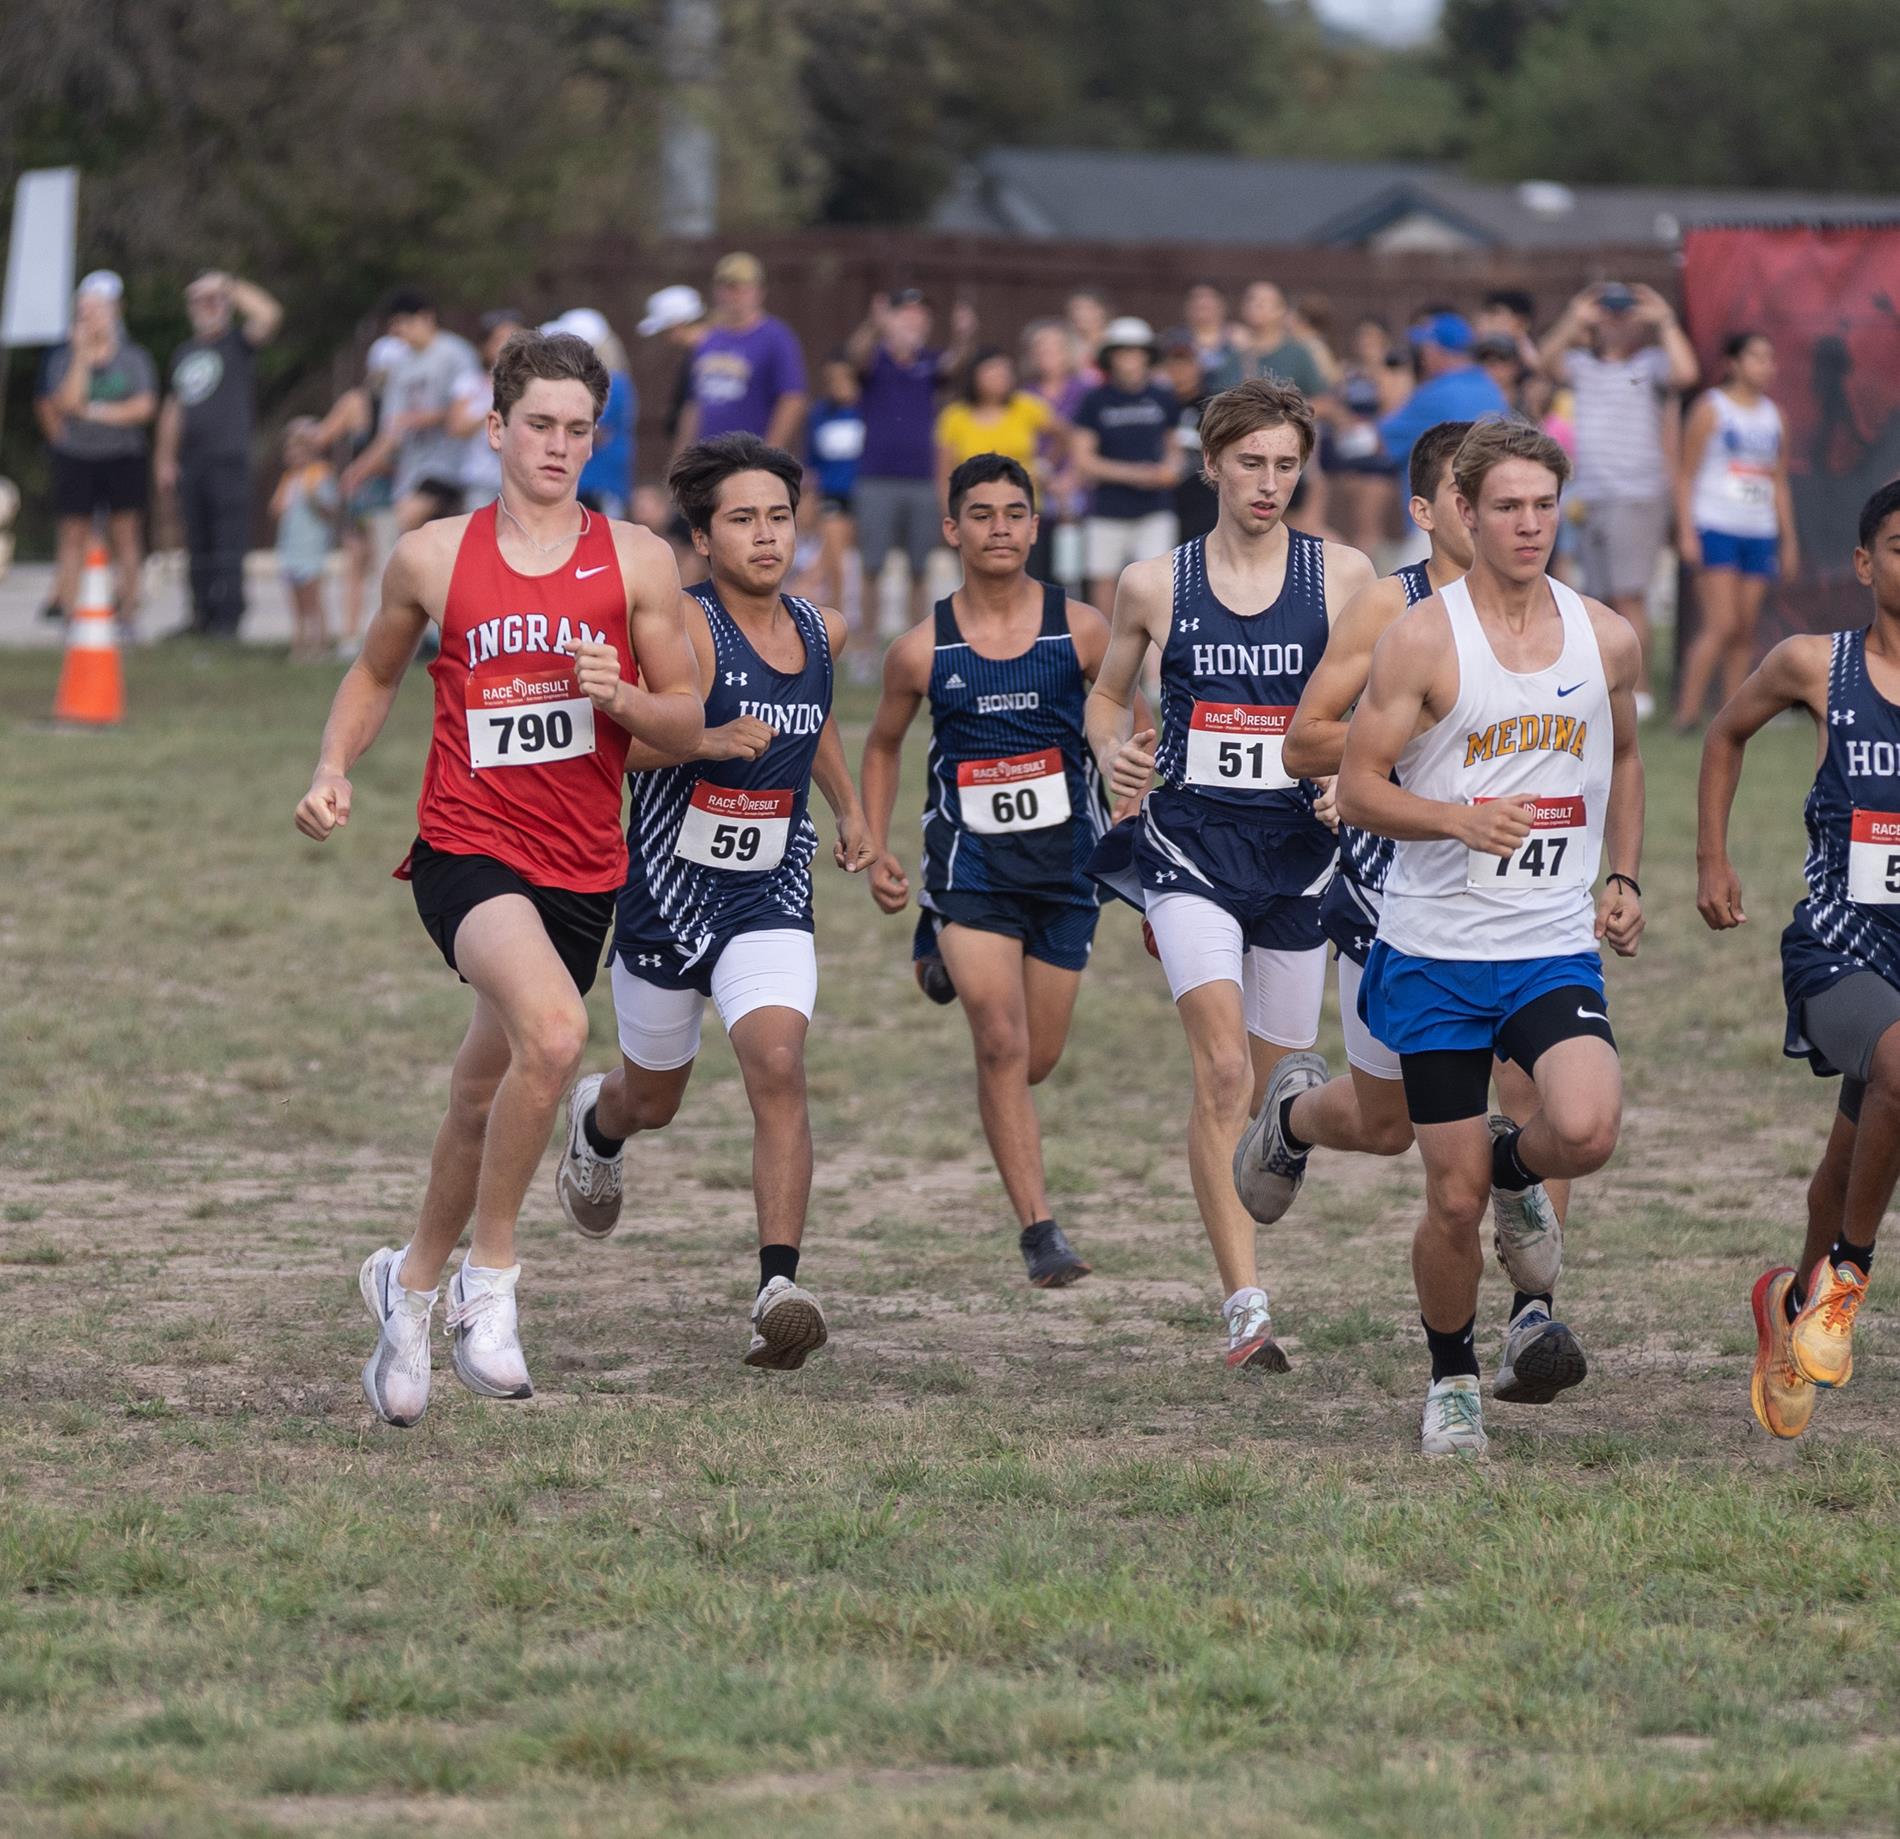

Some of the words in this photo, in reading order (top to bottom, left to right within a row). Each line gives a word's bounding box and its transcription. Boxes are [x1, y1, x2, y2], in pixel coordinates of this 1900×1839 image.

[466, 613, 607, 669] INGRAM
[1193, 643, 1303, 676] HONDO
[483, 686, 513, 700] RACE
[528, 679, 569, 695] RESULT
[976, 692, 1039, 714] HONDO
[489, 710, 573, 754] 790
[739, 701, 824, 734] HONDO
[1205, 712, 1233, 724] RACE
[1247, 715, 1286, 727] RESULT
[1463, 714, 1588, 768] MEDINA
[972, 768, 999, 779] RACE
[1010, 759, 1046, 775] RESULT
[1218, 741, 1264, 779] 51
[1846, 741, 1900, 776] HO
[708, 794, 737, 809] RACE
[747, 799, 780, 811] RESULT
[992, 788, 1039, 823] 60
[1536, 806, 1574, 820] RESULT
[710, 823, 761, 862] 59
[1872, 822, 1900, 836] RACE
